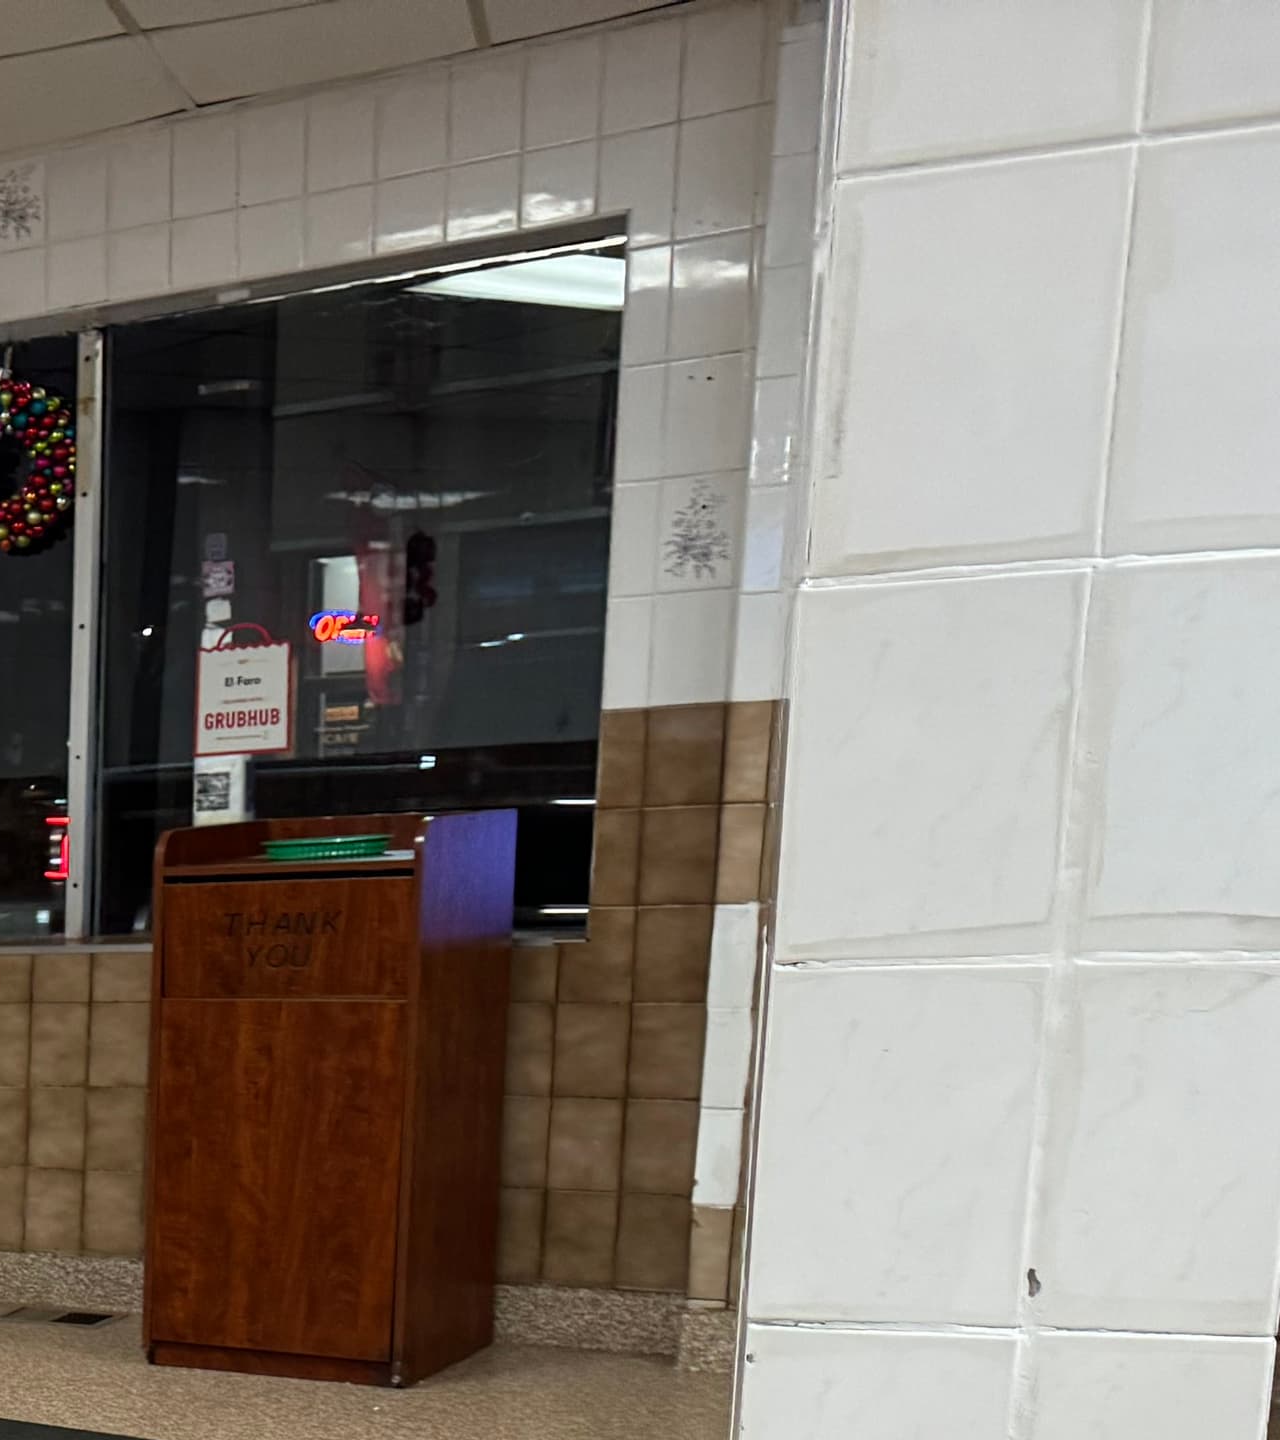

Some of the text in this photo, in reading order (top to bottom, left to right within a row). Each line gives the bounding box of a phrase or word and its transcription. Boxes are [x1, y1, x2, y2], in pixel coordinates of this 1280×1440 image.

[237, 675, 262, 686] Faro
[204, 707, 280, 731] GRUBHUB
[223, 910, 342, 937] THANK
[246, 944, 312, 969] YOU
